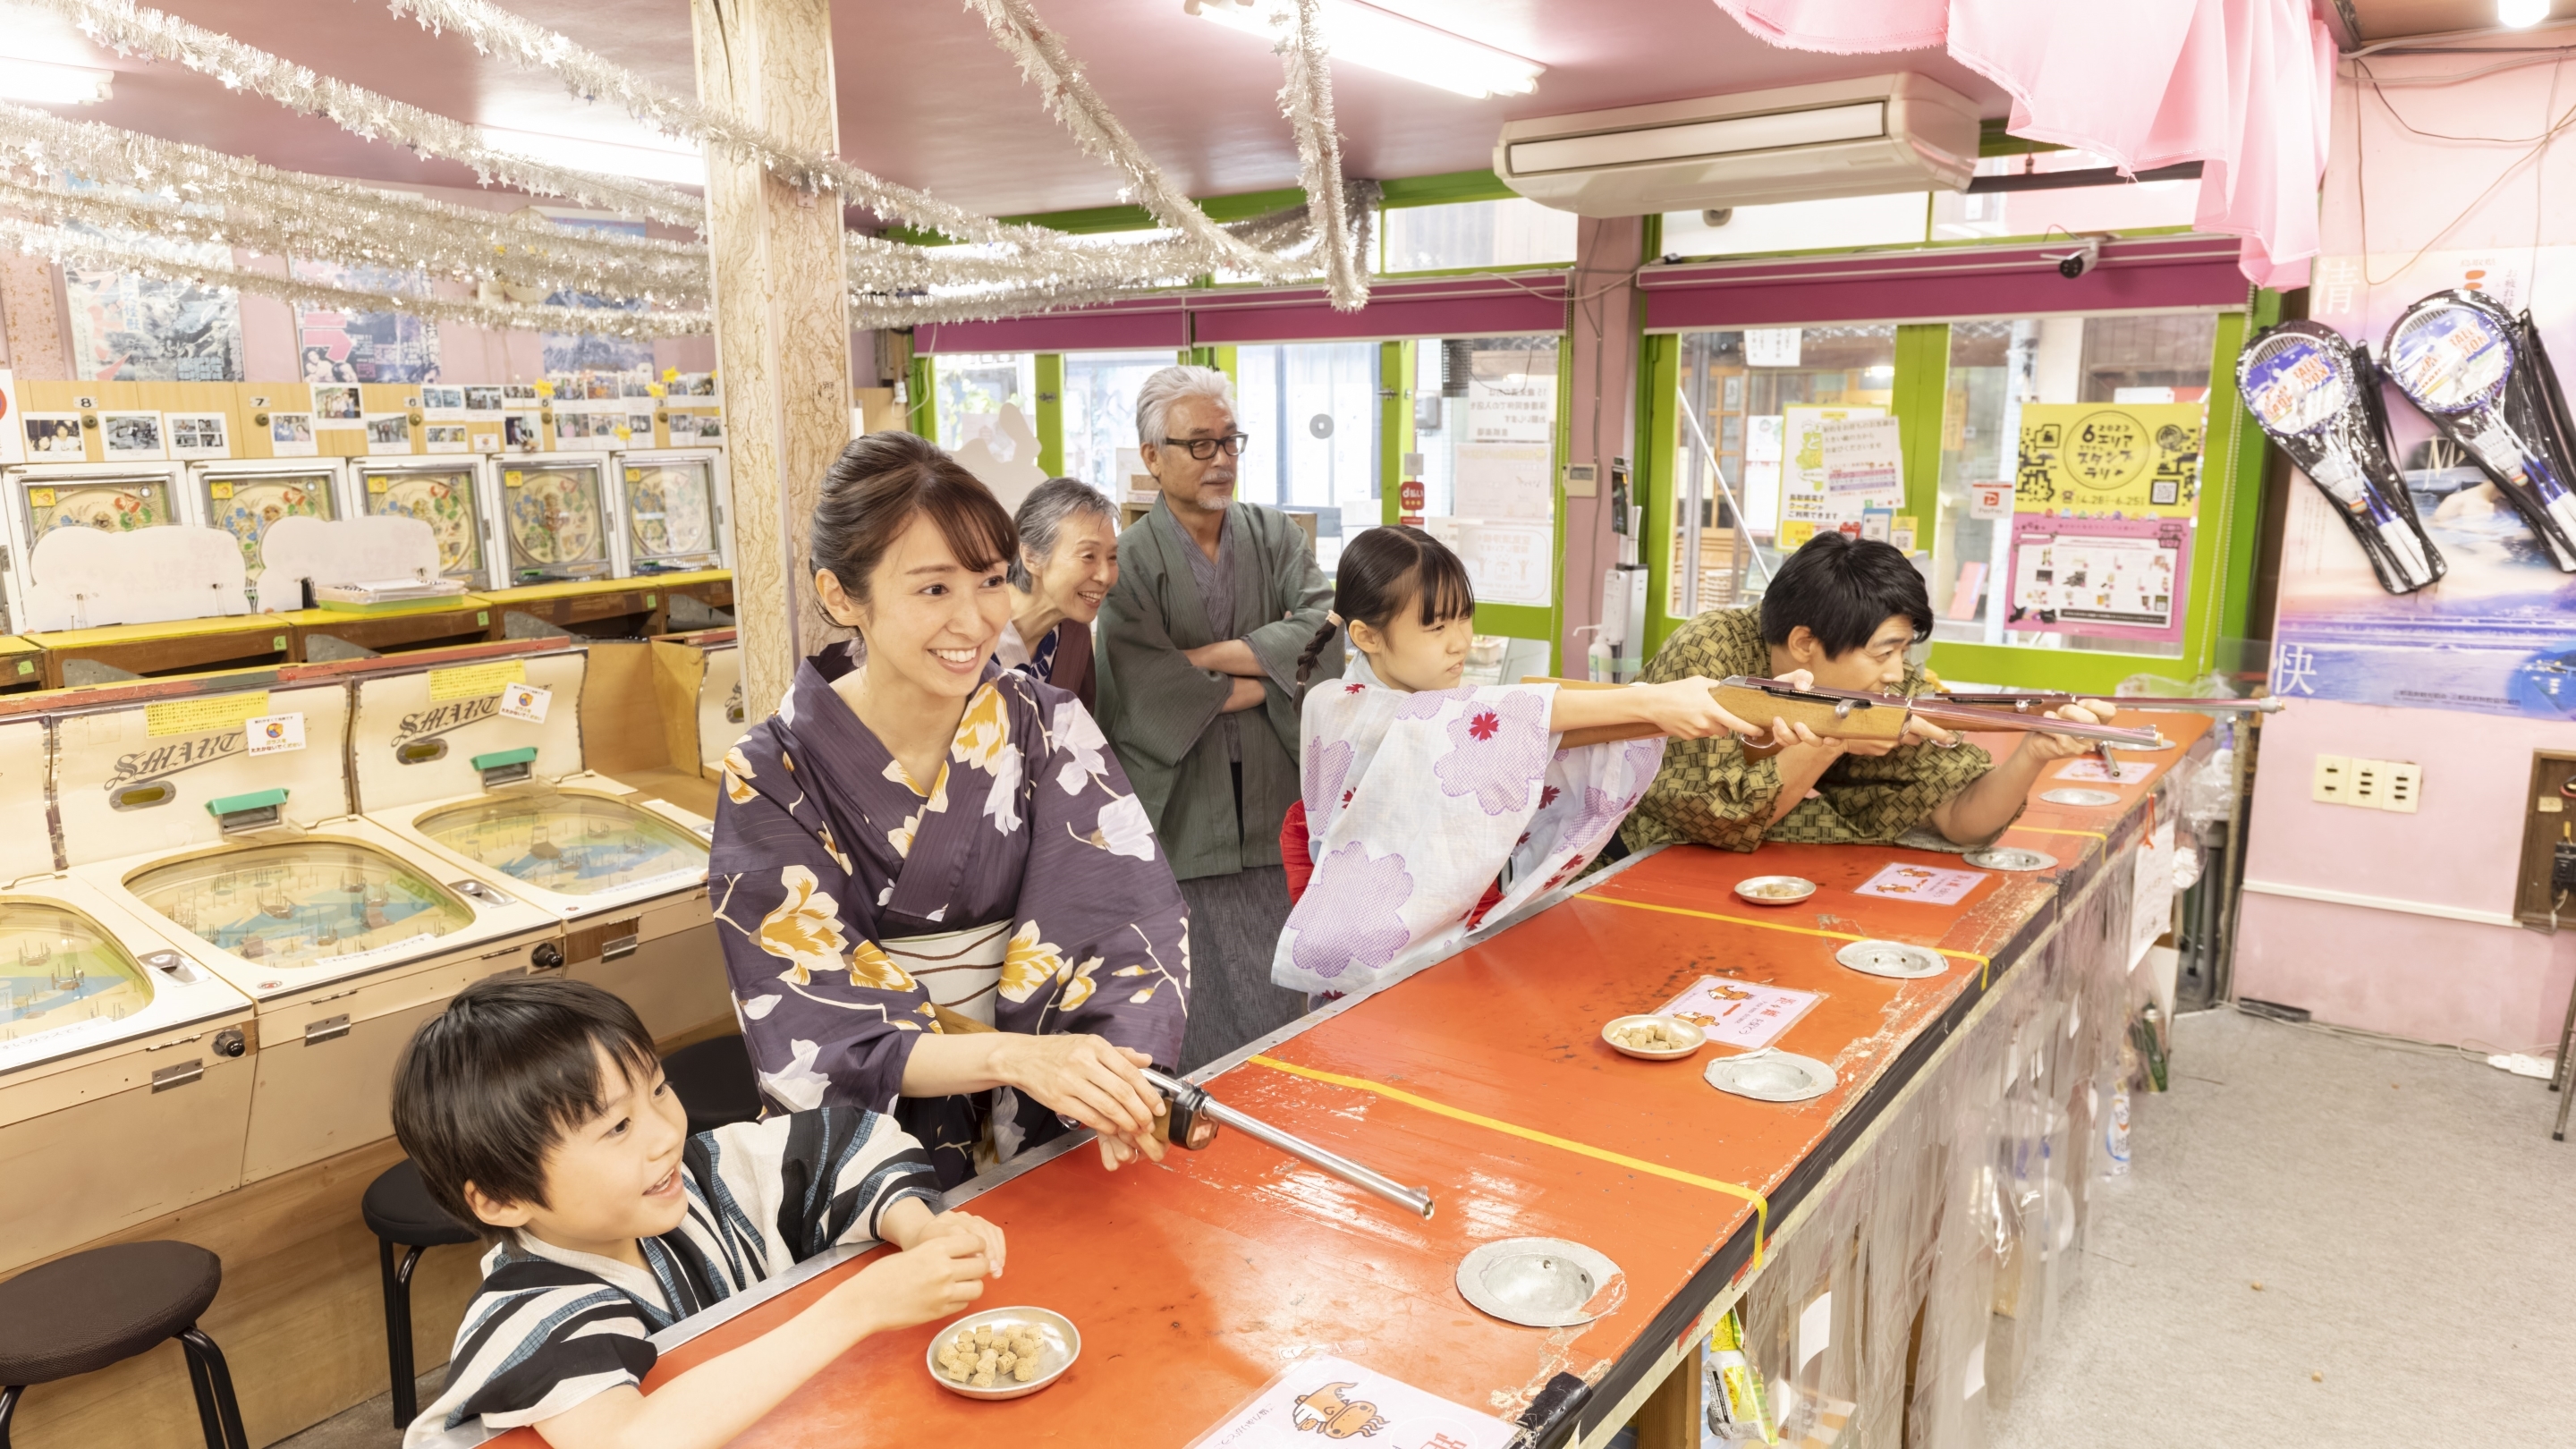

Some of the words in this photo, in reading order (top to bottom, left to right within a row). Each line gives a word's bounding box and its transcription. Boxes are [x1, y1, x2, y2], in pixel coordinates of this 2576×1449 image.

[2315, 261, 2359, 316] 清
[80, 397, 92, 408] 8
[255, 398, 265, 406] 7
[2078, 449, 2134, 465] スタンプ
[1788, 511, 1838, 520] ご利用できます
[2274, 644, 2318, 696] 快
[391, 695, 502, 748] SMART
[103, 729, 245, 791] SMART
